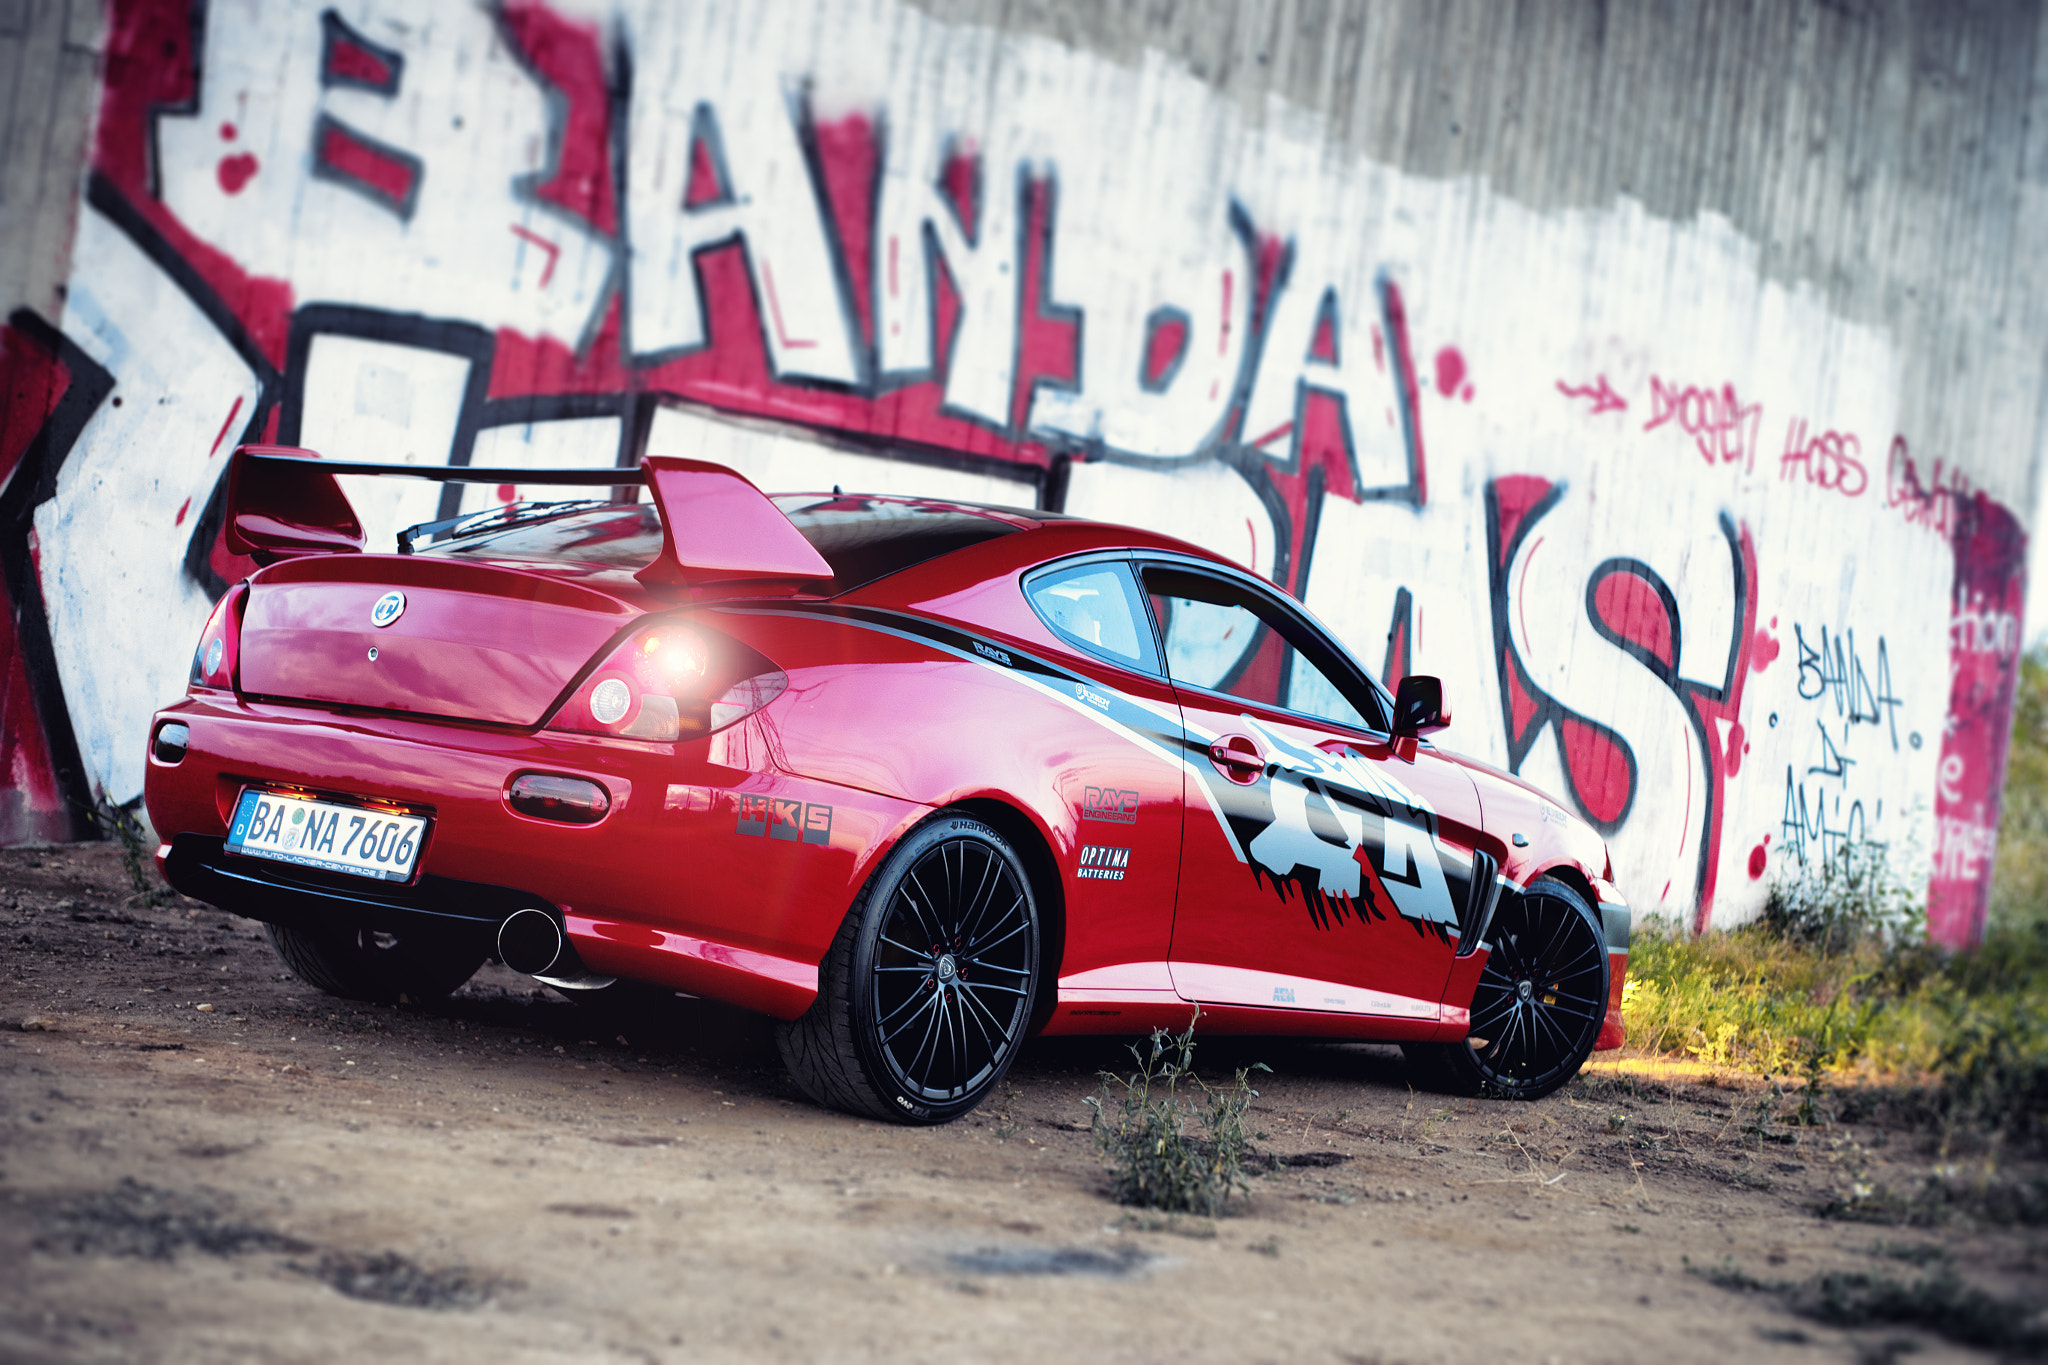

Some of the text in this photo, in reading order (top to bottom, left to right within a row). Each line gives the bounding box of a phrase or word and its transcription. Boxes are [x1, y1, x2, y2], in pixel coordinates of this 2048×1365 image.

[1084, 786, 1138, 813] RAYS
[738, 795, 832, 838] HKS
[1084, 809, 1136, 823] ENGINEERING
[235, 824, 245, 836] D
[249, 801, 418, 866] BA NA 7606
[1080, 846, 1129, 868] OPTIMA
[1077, 868, 1125, 881] BATTERIES
